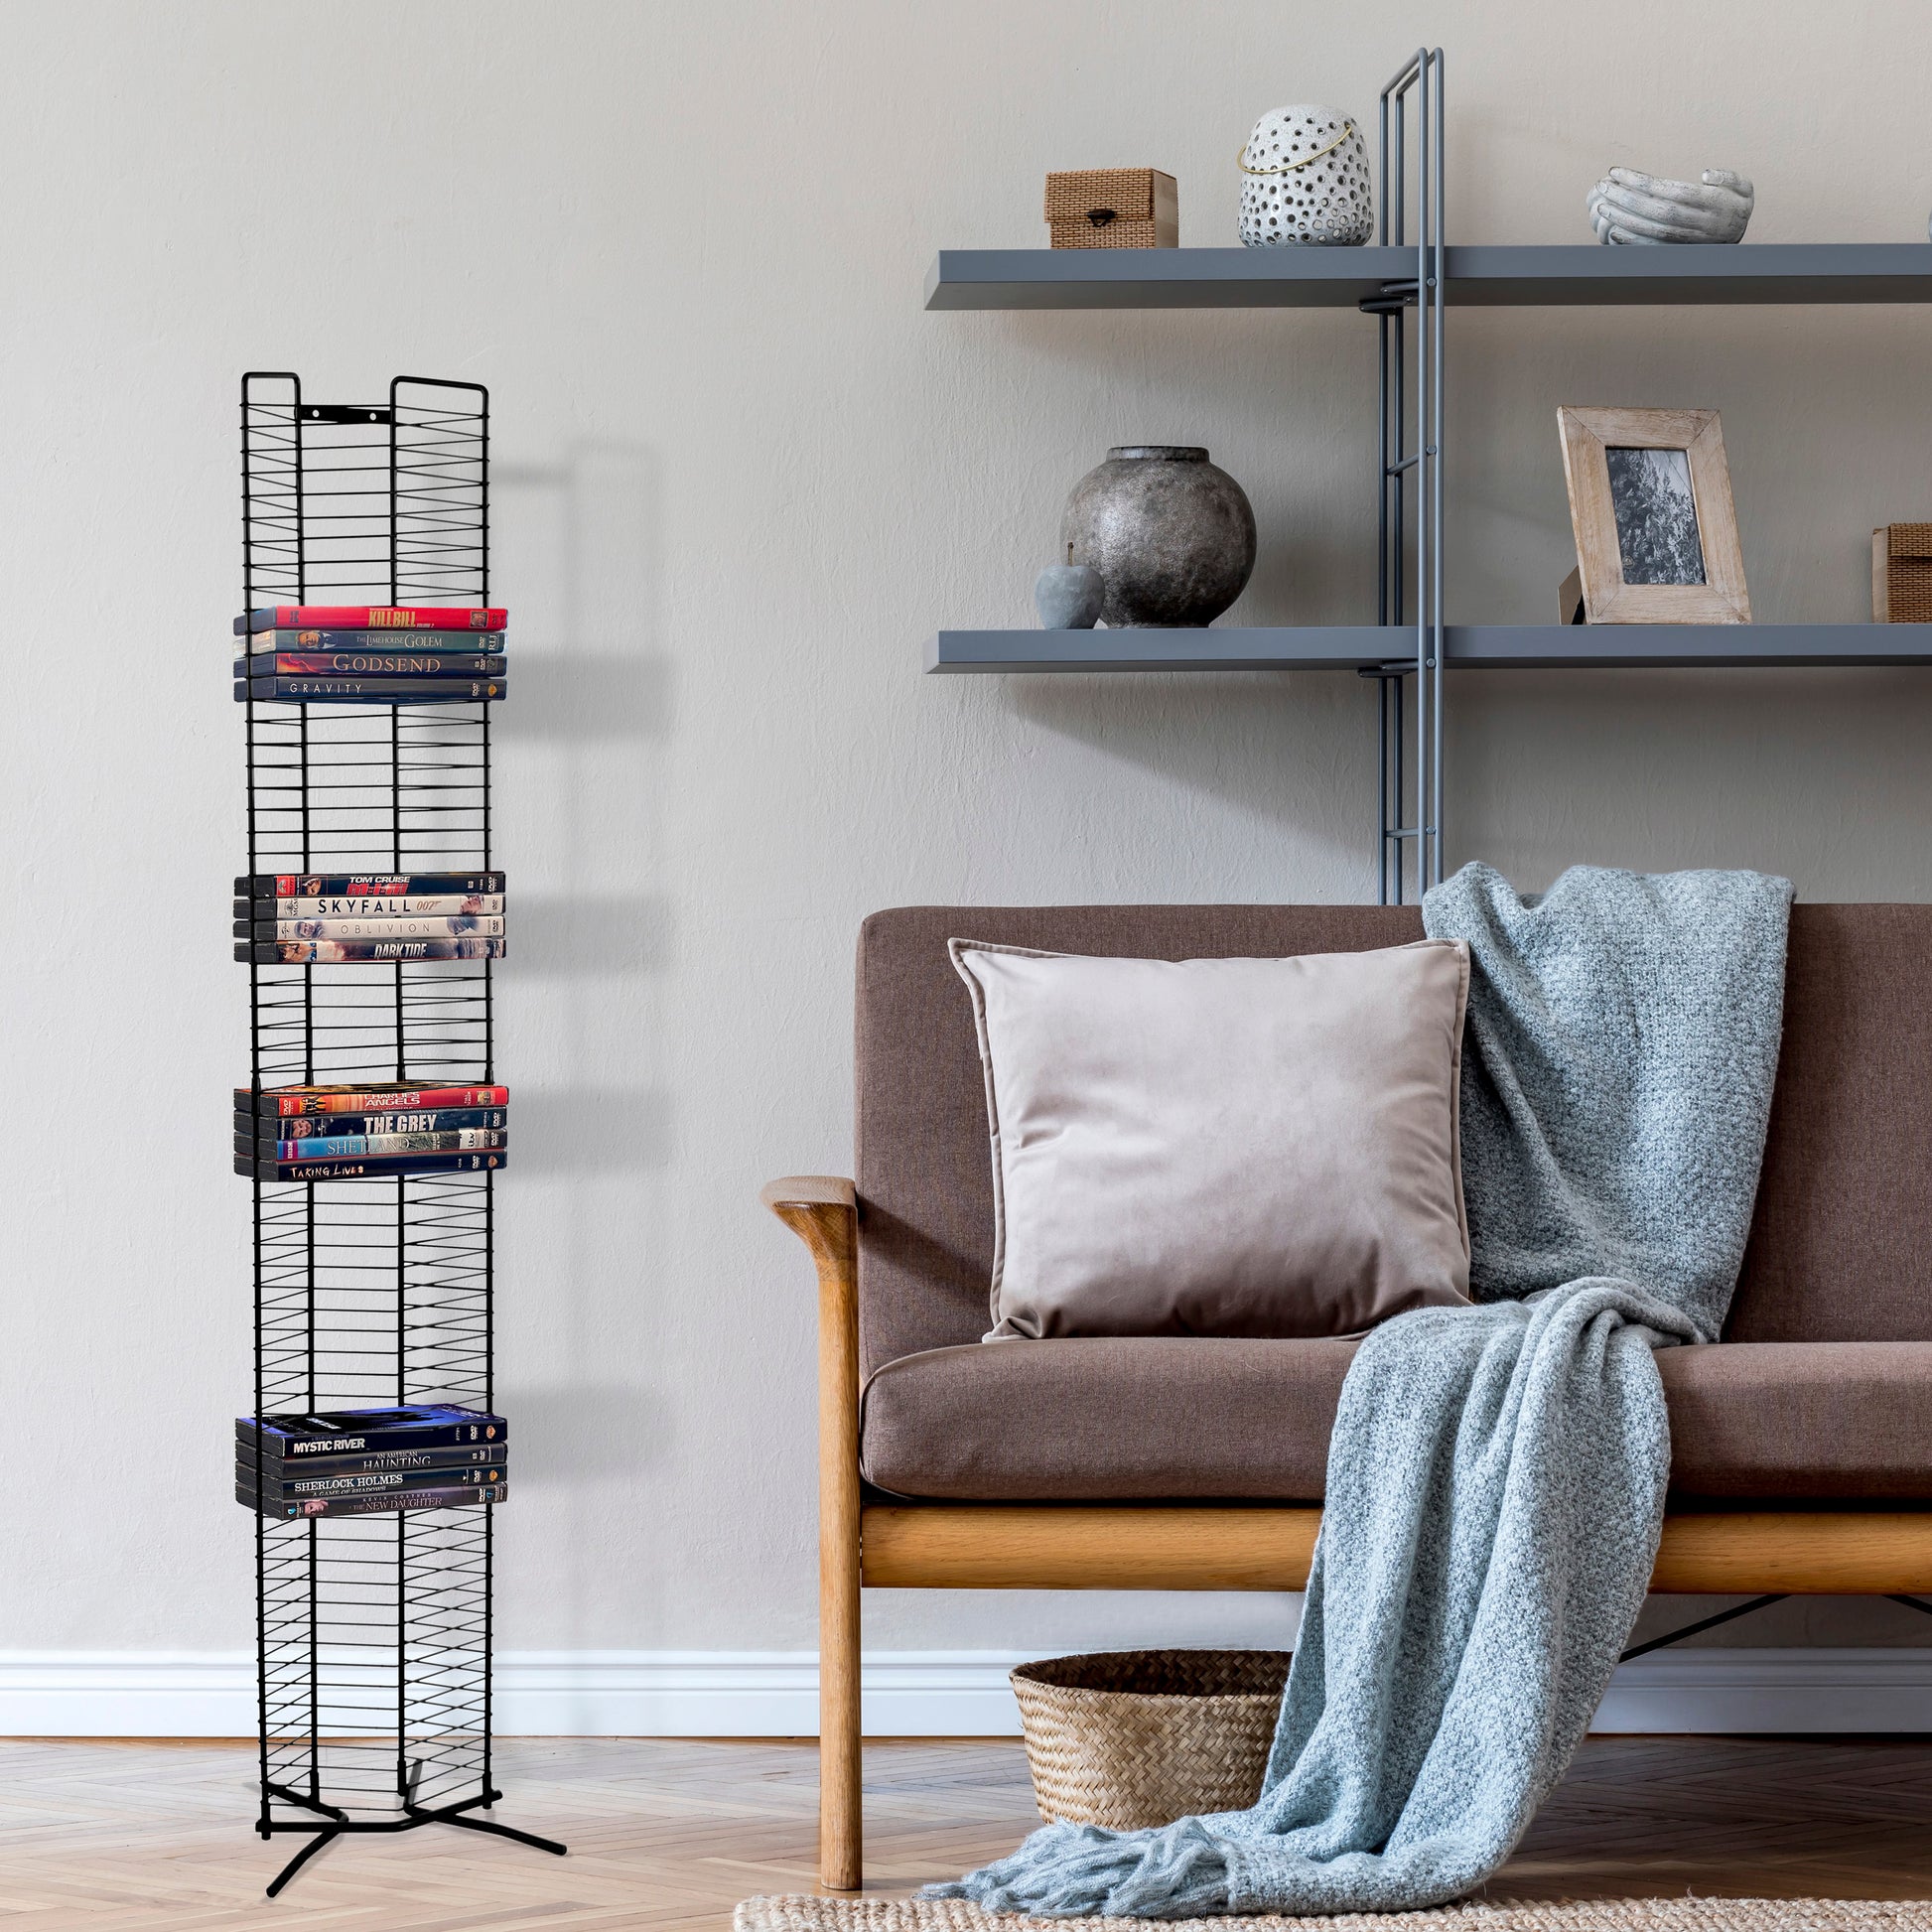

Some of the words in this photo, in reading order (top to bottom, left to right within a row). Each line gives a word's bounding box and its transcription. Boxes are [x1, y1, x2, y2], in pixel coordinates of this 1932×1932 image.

[367, 611, 392, 627] KILL
[392, 611, 416, 627] BILL
[366, 634, 404, 646] LIMEHOUSE
[404, 633, 443, 648] GOLEM
[488, 634, 497, 650] RLJ
[333, 653, 441, 673] GODSEND
[289, 683, 362, 693] GRAVITY
[318, 898, 411, 913] SKYFALL
[416, 900, 442, 911] 007
[341, 923, 430, 934] OBLIVION
[373, 943, 404, 959] DARK
[405, 942, 428, 958] TIDE
[364, 1098, 420, 1107] ANGELS
[363, 1116, 393, 1135] THE
[397, 1114, 437, 1133] GREY
[327, 1136, 410, 1155] SHETLAND
[290, 1166, 330, 1178] TAKING
[334, 1164, 364, 1175] LIVES
[293, 1440, 333, 1453] MYSTIC
[334, 1438, 365, 1450] RIVER
[386, 1450, 418, 1459] AMERICAN
[363, 1455, 431, 1471] HAUNTING
[294, 1478, 354, 1492] SHERLOCK
[357, 1474, 403, 1487] HOLMES
[365, 1501, 388, 1511] NEW
[390, 1497, 443, 1509] DAUGHTER
